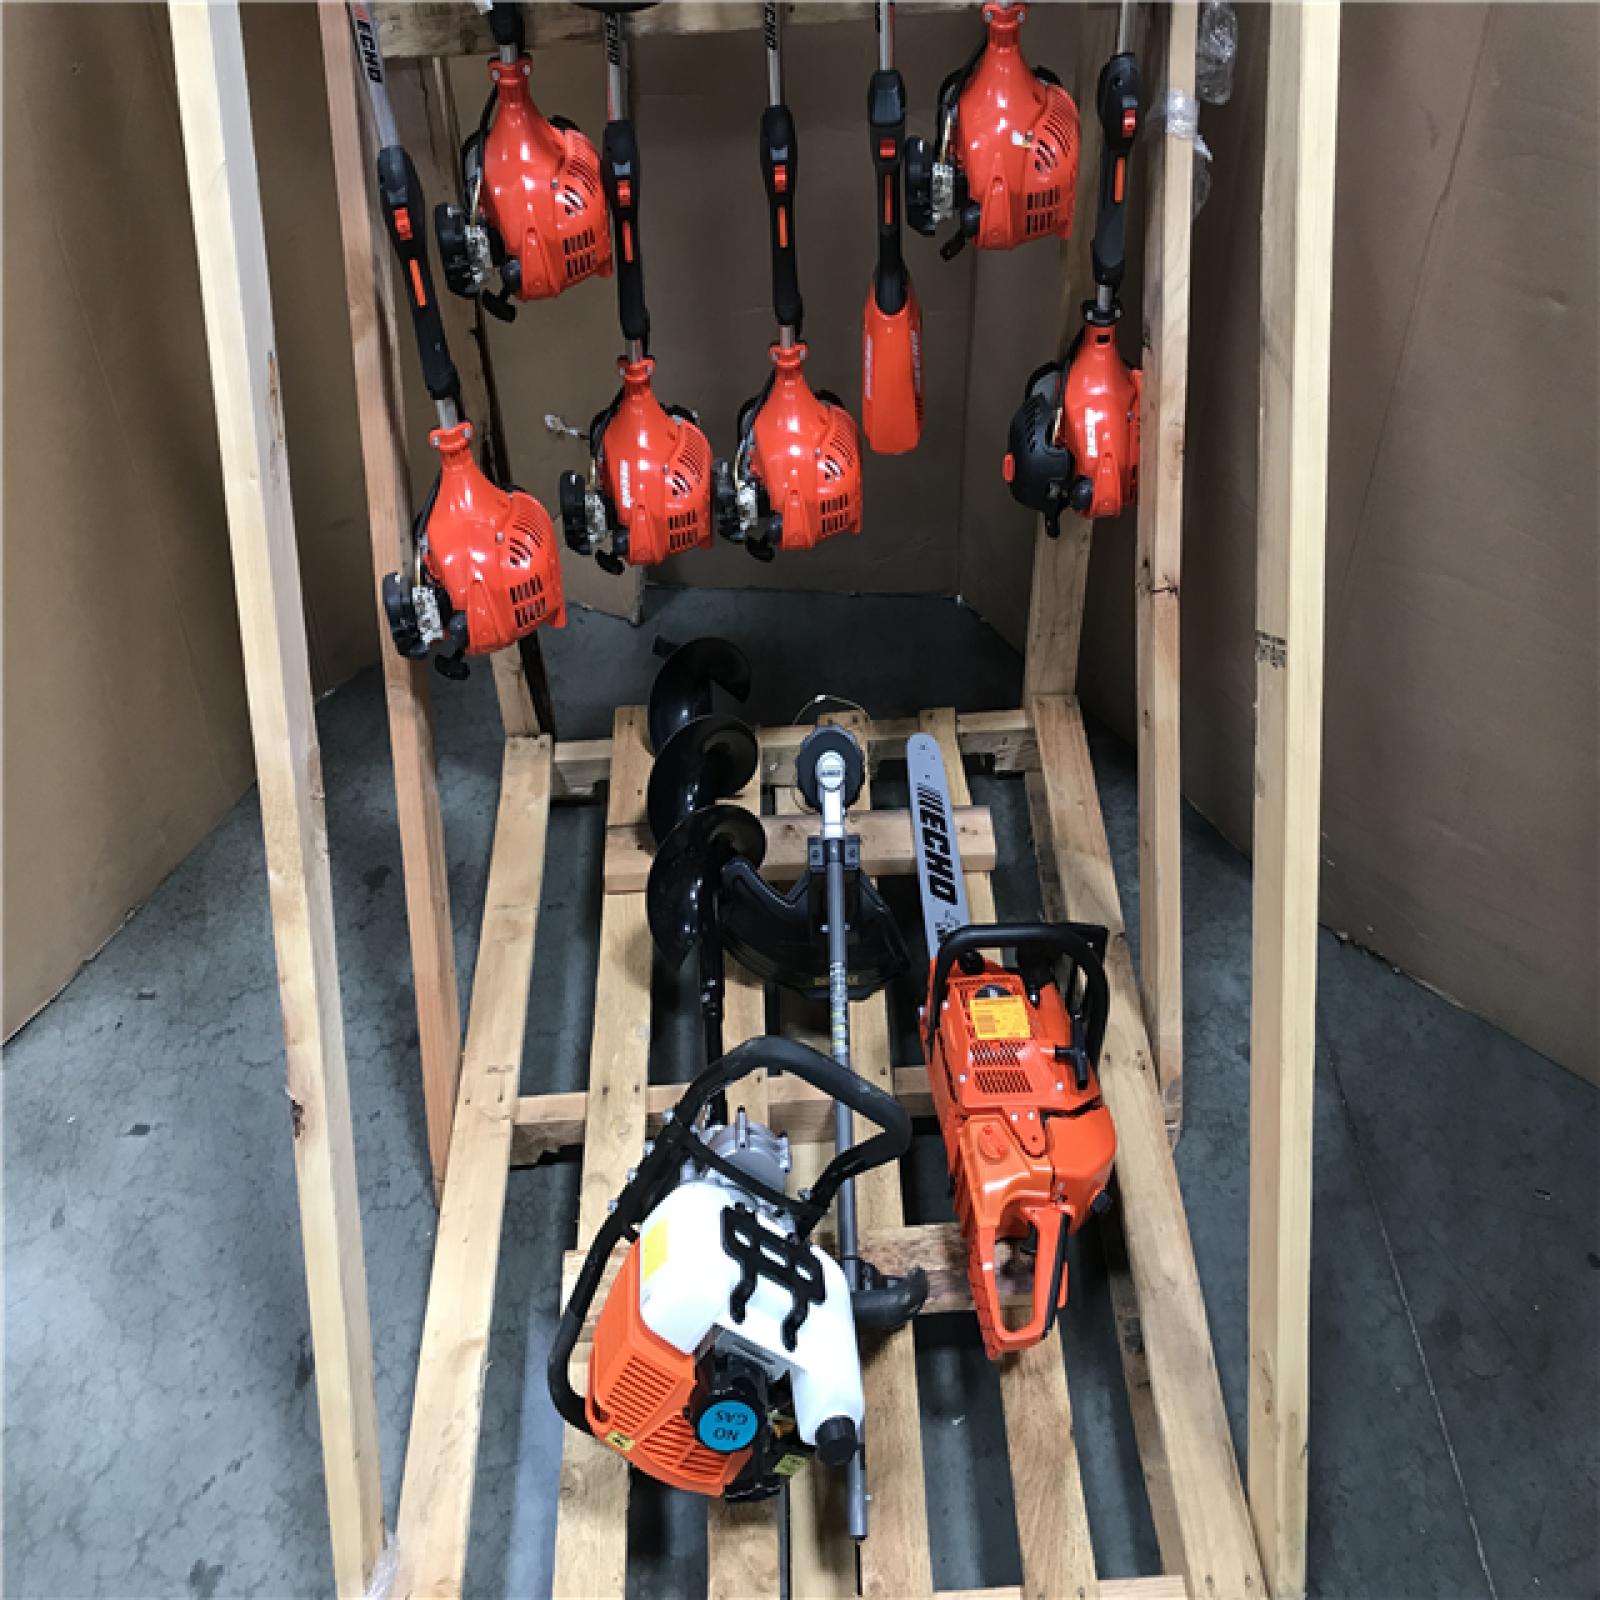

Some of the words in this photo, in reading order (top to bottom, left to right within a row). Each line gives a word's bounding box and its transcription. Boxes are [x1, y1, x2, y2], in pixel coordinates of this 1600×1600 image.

[356, 19, 383, 83] ECHO
[919, 807, 958, 906] ECHO
[713, 1427, 738, 1442] NO
[715, 1410, 748, 1426] GAS
